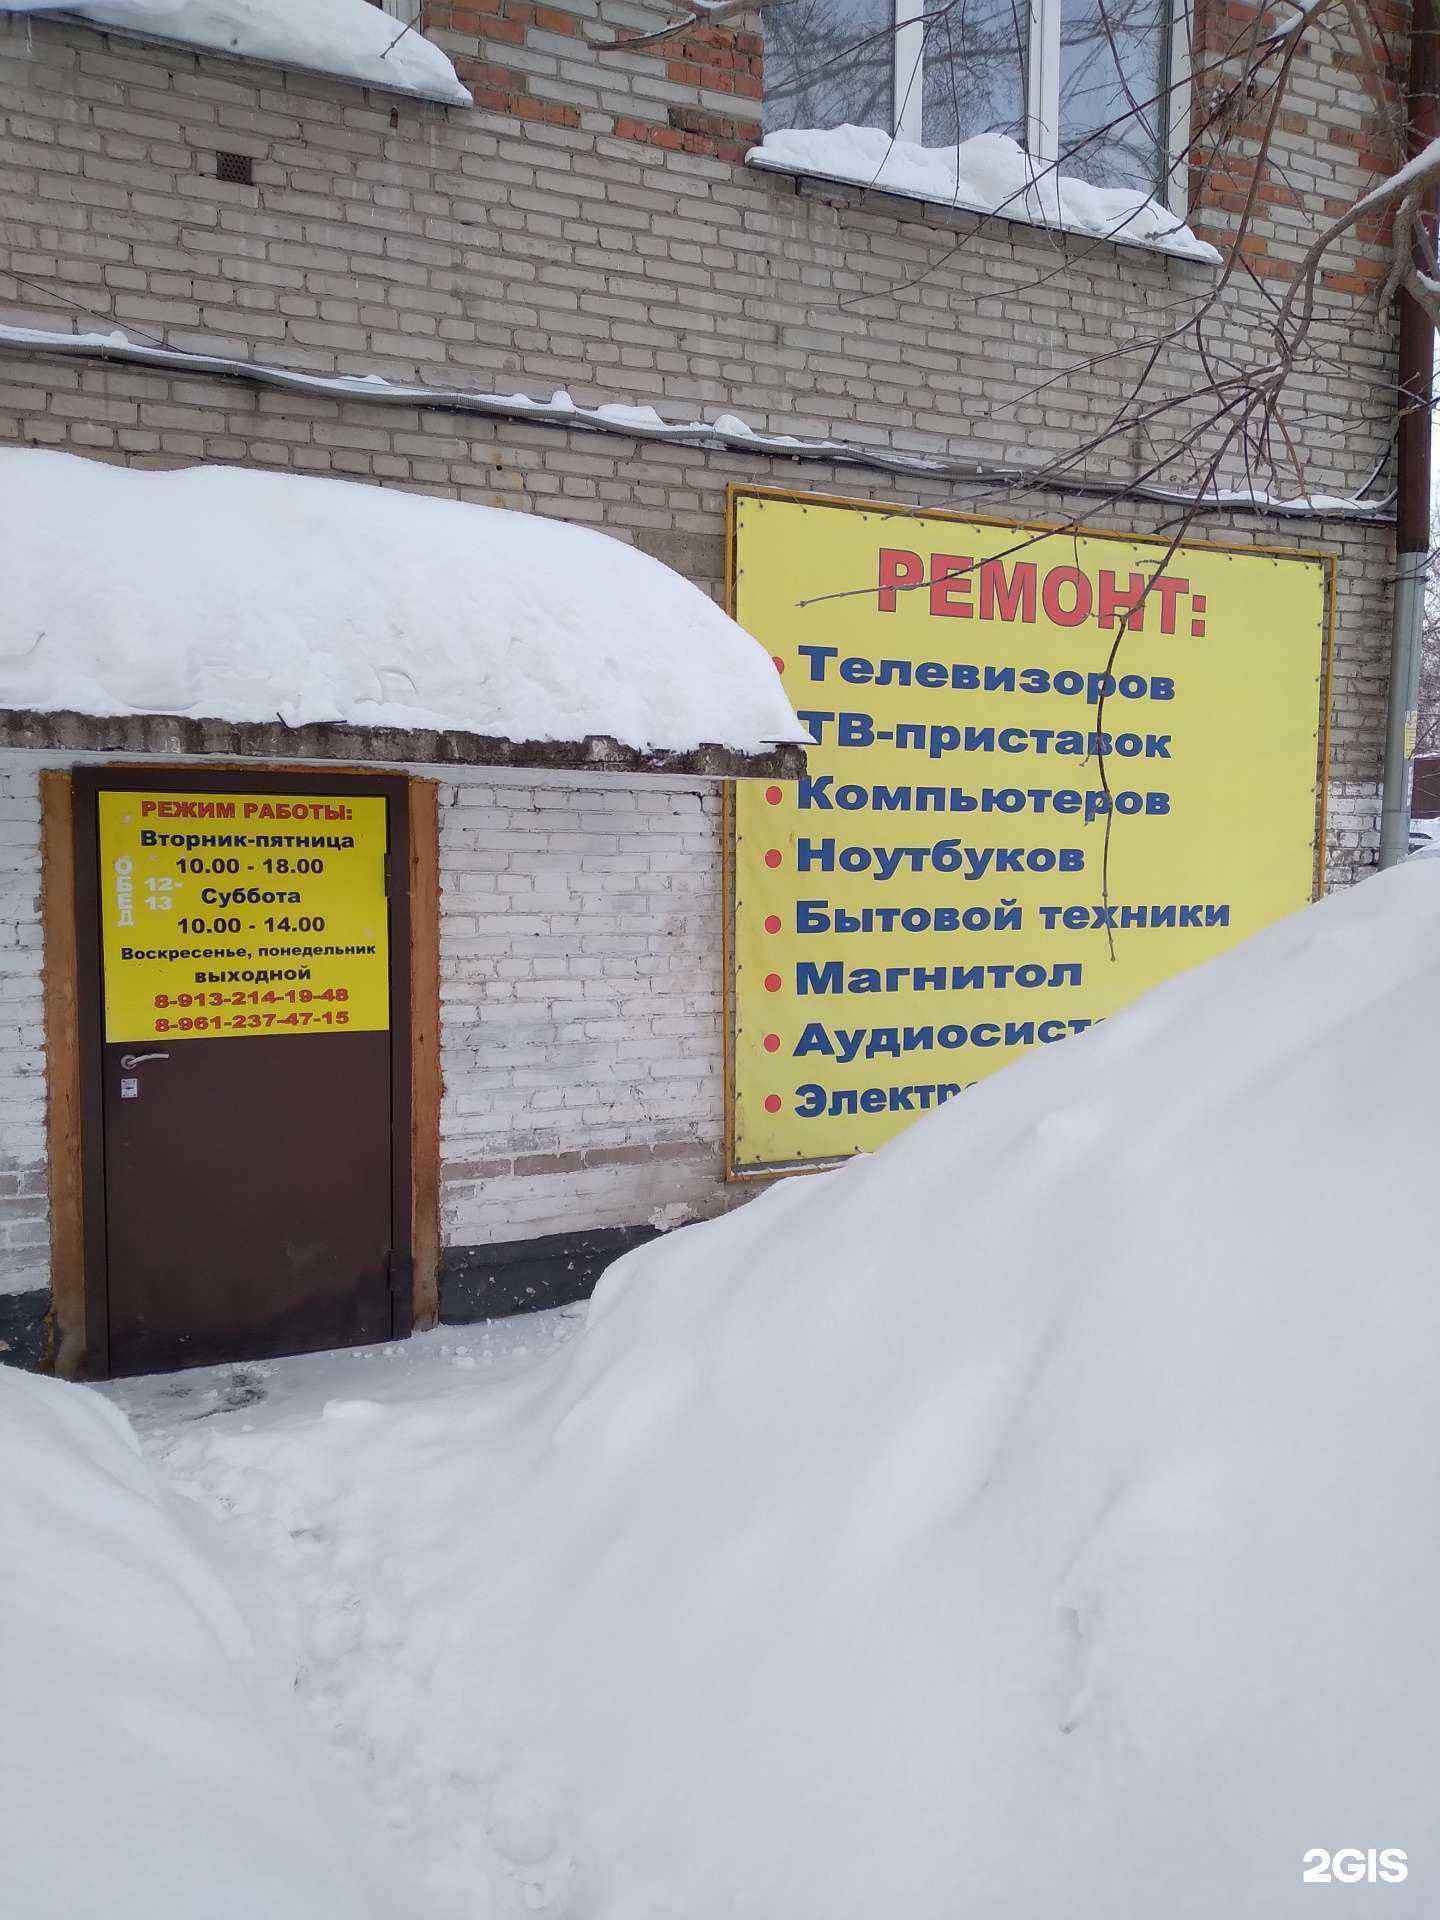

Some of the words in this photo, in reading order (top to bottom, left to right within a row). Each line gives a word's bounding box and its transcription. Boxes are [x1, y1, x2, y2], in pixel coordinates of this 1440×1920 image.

[877, 547, 1207, 638] РЕМОНТ:
[797, 645, 1176, 705] Телевизоров
[796, 710, 1172, 759] ТВ-приставок
[140, 800, 236, 819] РЕЖИМ
[243, 803, 353, 821] РАБОТЫ:
[797, 775, 1171, 823] Компьютеров
[140, 830, 355, 850] Вторник-пятница
[176, 858, 240, 874] 10.00
[262, 858, 324, 874] 18.00
[796, 838, 1085, 881] Ноутбуков
[200, 887, 301, 909] Суббота
[177, 917, 241, 934] 10.00
[264, 916, 326, 933] 14.00
[796, 898, 1023, 934] Бытовой
[1039, 903, 1231, 930] техники
[120, 946, 252, 961] Воскресенье,
[258, 943, 376, 959] понедельник
[194, 965, 311, 984] выходной
[796, 961, 1083, 995] Магнитол
[153, 988, 349, 1009] 8-913-214-19-48
[153, 1011, 350, 1033] 8-961-237-47-15
[792, 1017, 1106, 1063] Аудиосист
[793, 1081, 978, 1118] Электр
